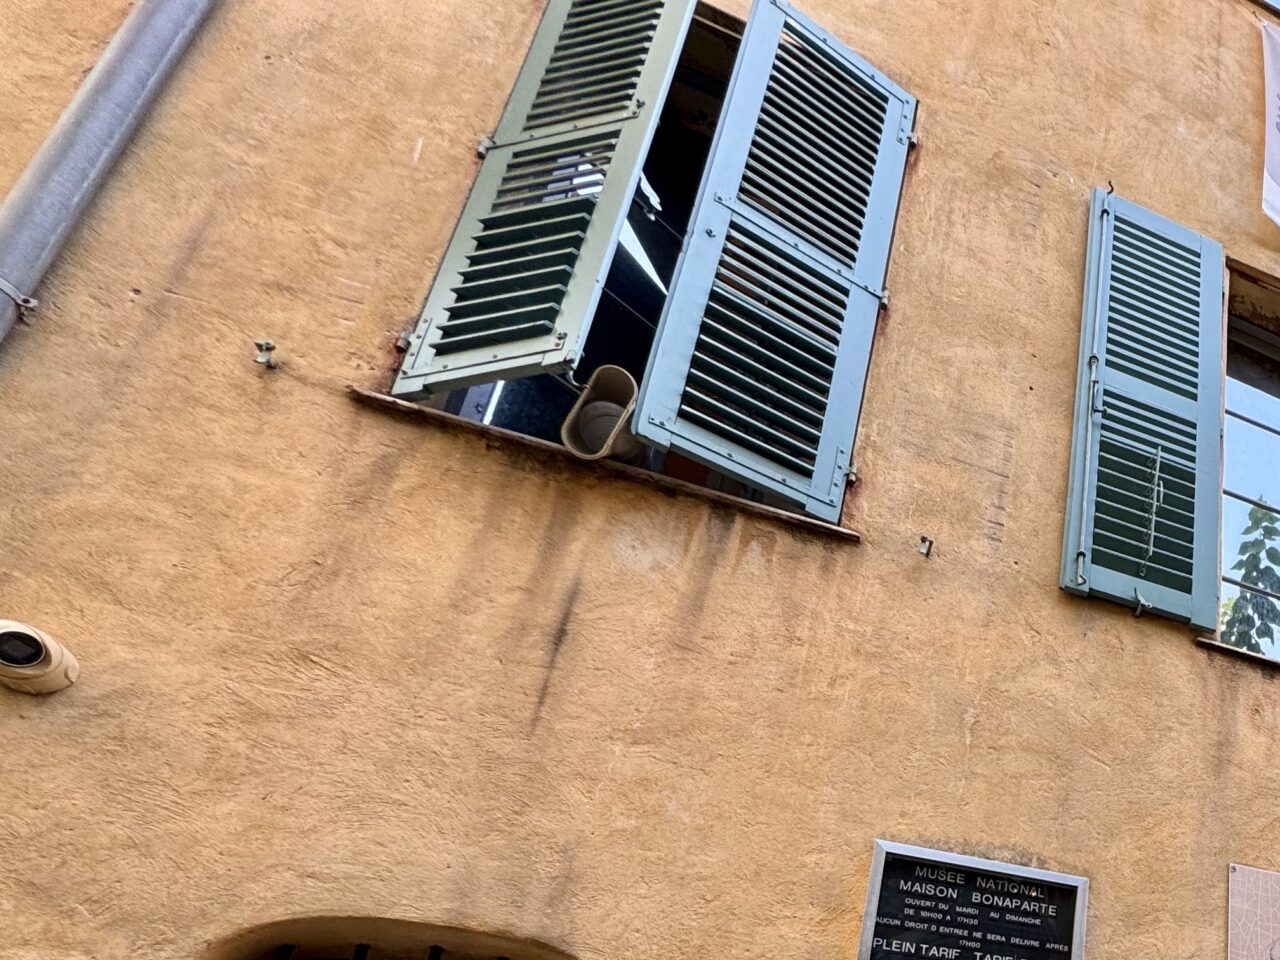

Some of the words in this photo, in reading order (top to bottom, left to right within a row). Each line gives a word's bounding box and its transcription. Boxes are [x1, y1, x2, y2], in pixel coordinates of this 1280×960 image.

[899, 880, 958, 899] MAISON
[972, 892, 1057, 916] BONAPARTE
[976, 877, 1045, 898] NATIONAL
[904, 908, 915, 916] DE
[905, 898, 936, 908] OUVERT
[956, 906, 979, 915] MARDI
[1005, 914, 1041, 925] DIMANCHE
[876, 917, 901, 926] AUCUN
[904, 921, 928, 930] DROIT
[939, 926, 969, 936] ENTREE
[1010, 937, 1040, 947] DELIVRE
[873, 938, 916, 954] PLEIN
[920, 944, 961, 959] TARIF
